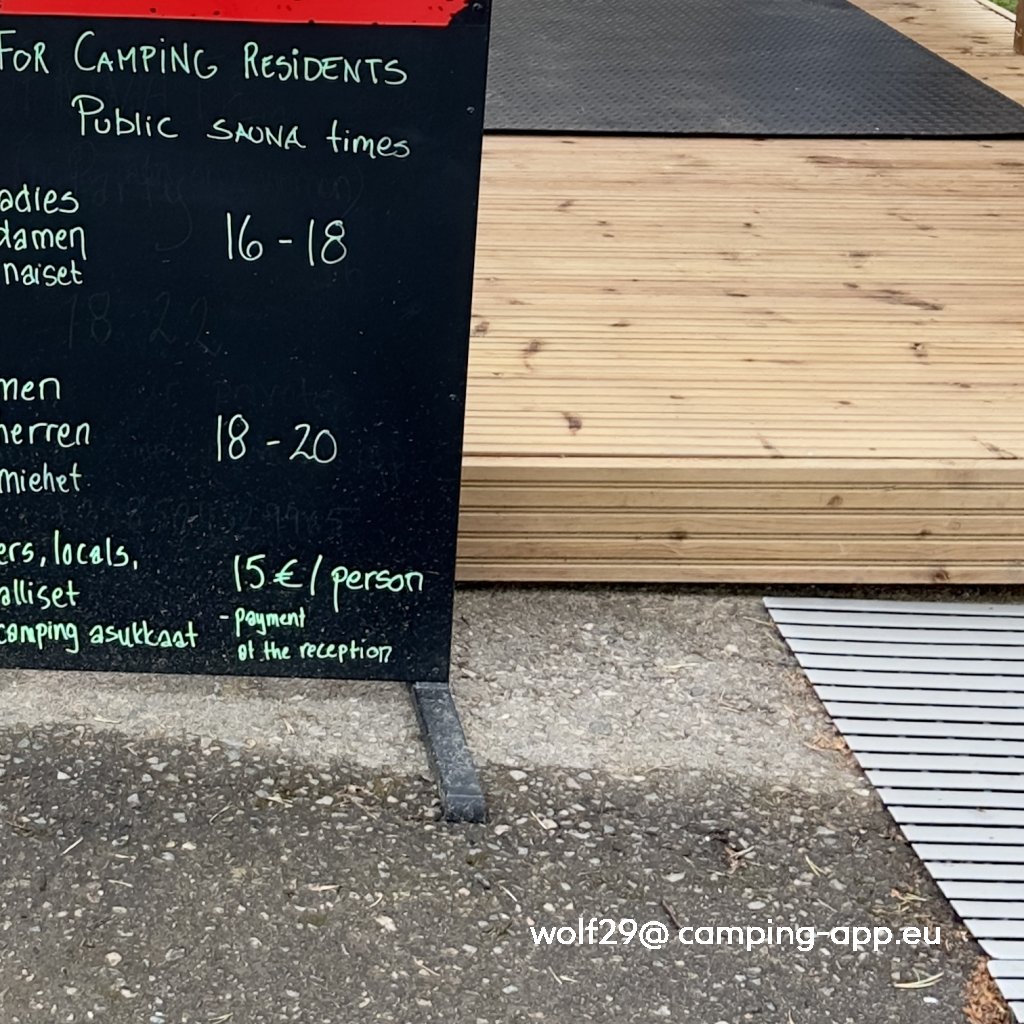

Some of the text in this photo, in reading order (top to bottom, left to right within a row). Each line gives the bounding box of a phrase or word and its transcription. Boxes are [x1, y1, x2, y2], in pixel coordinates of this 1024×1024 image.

[72, 95, 410, 160] Public SAUNA times
[4, 259, 83, 287] naiset
[263, 640, 292, 661] the
[299, 639, 393, 664] reception
